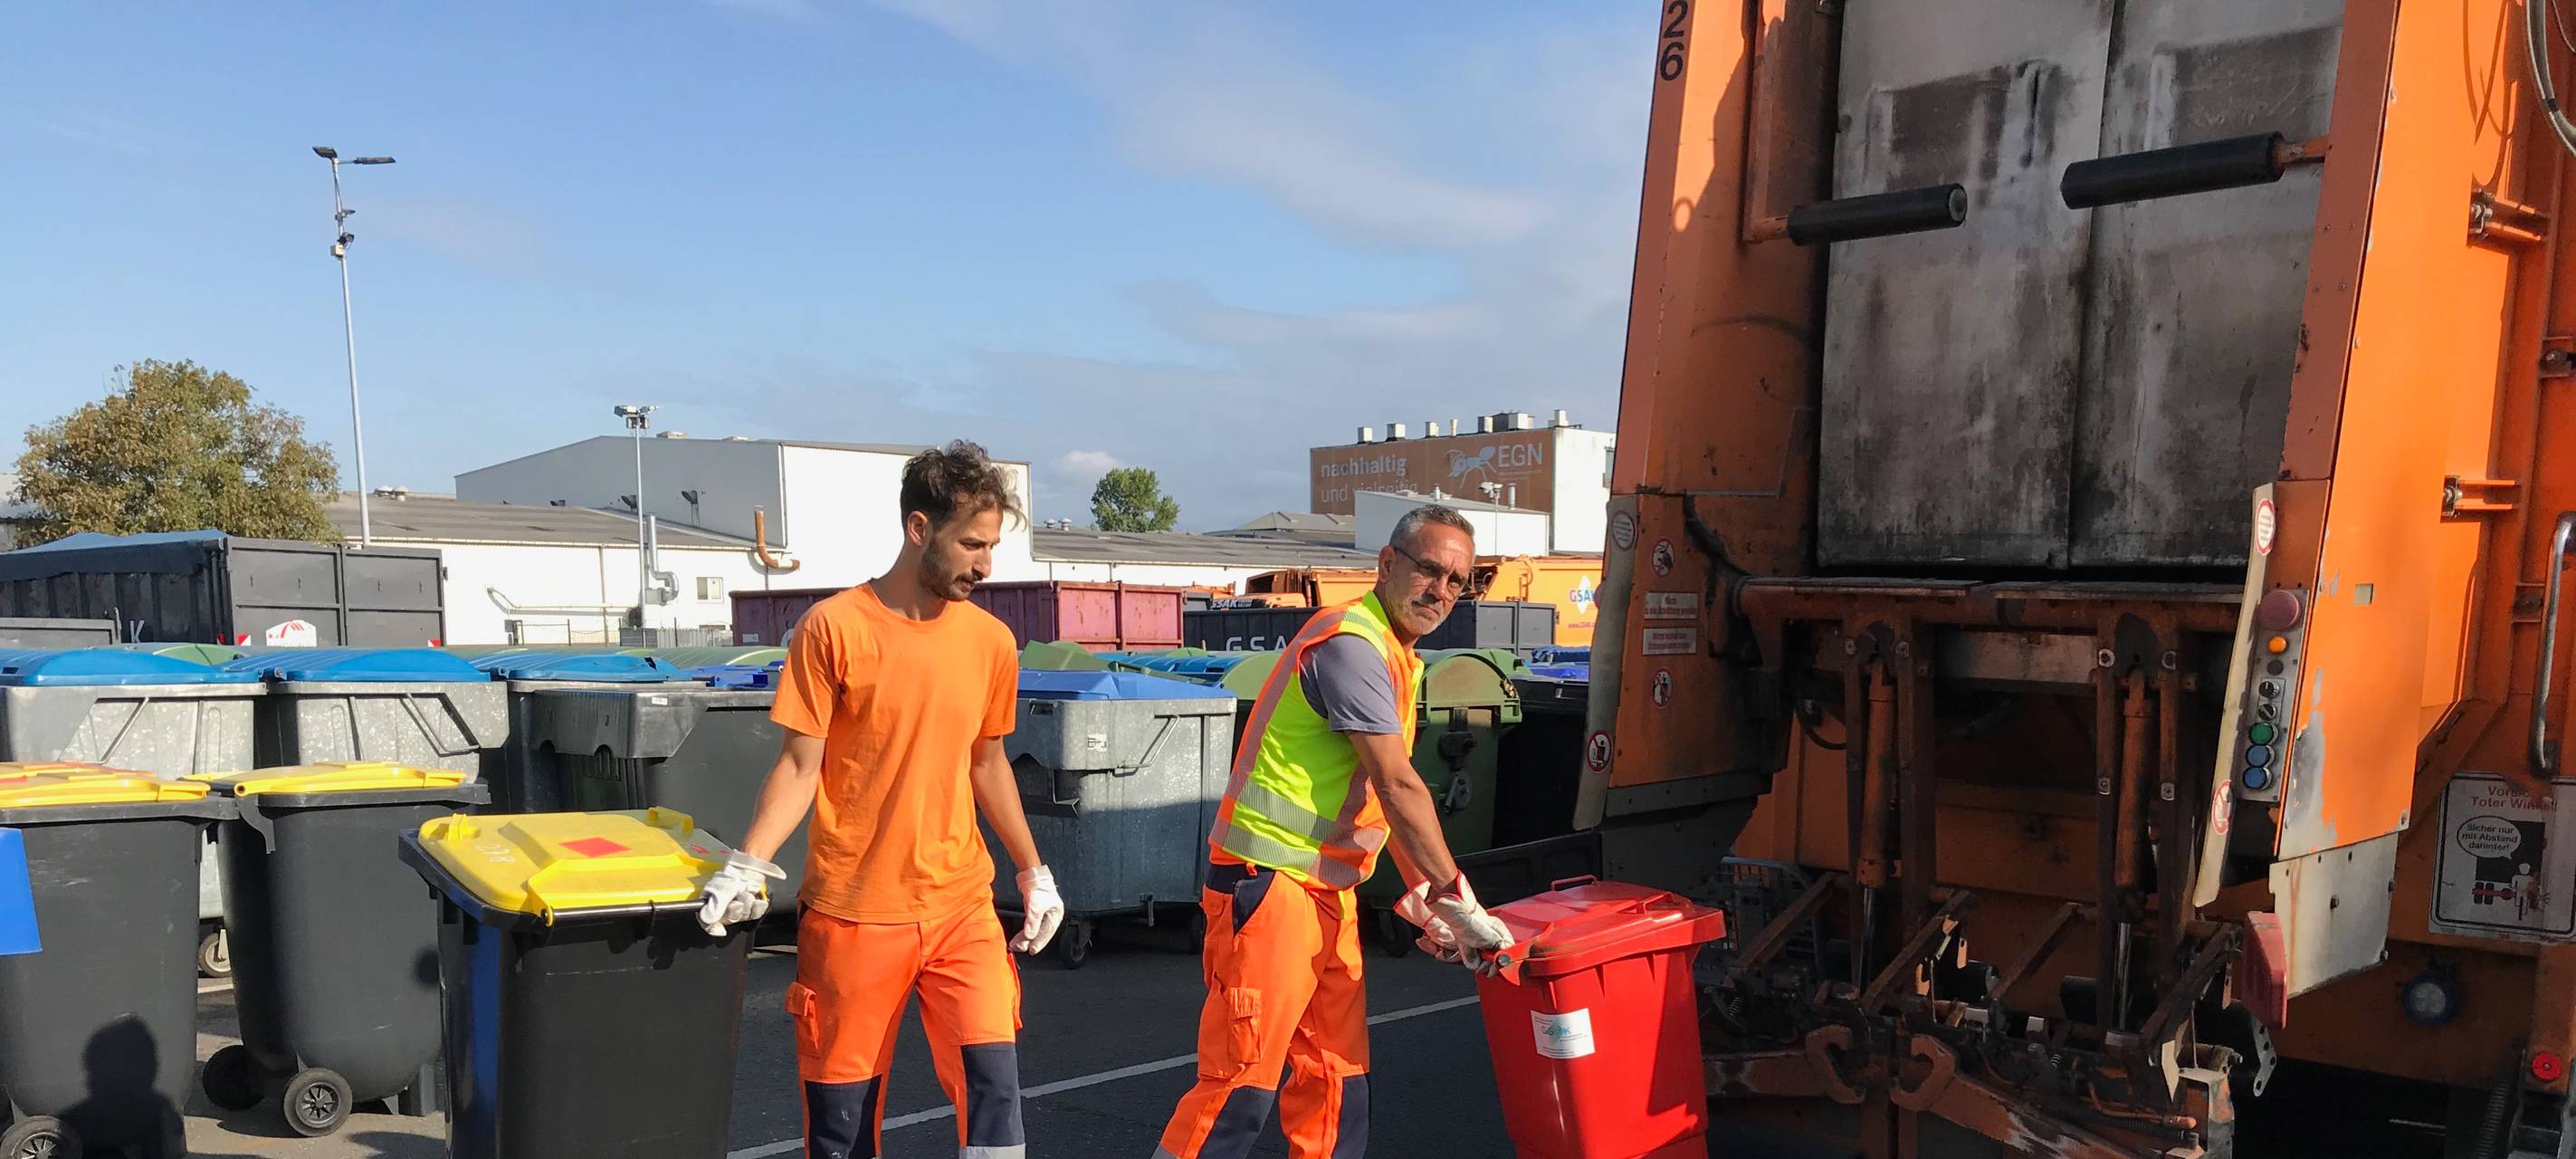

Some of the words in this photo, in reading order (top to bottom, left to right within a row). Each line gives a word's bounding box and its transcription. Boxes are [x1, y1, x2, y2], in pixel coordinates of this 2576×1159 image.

[1661, 0, 1688, 81] 26
[1498, 443, 1543, 468] EGN
[1321, 454, 1407, 477] nachhaltig
[1321, 482, 1348, 503] und
[1226, 636, 1287, 652] GSA
[2471, 797, 2506, 808] Toter
[2466, 824, 2496, 833] Sicher
[2479, 833, 2518, 843] Abstand
